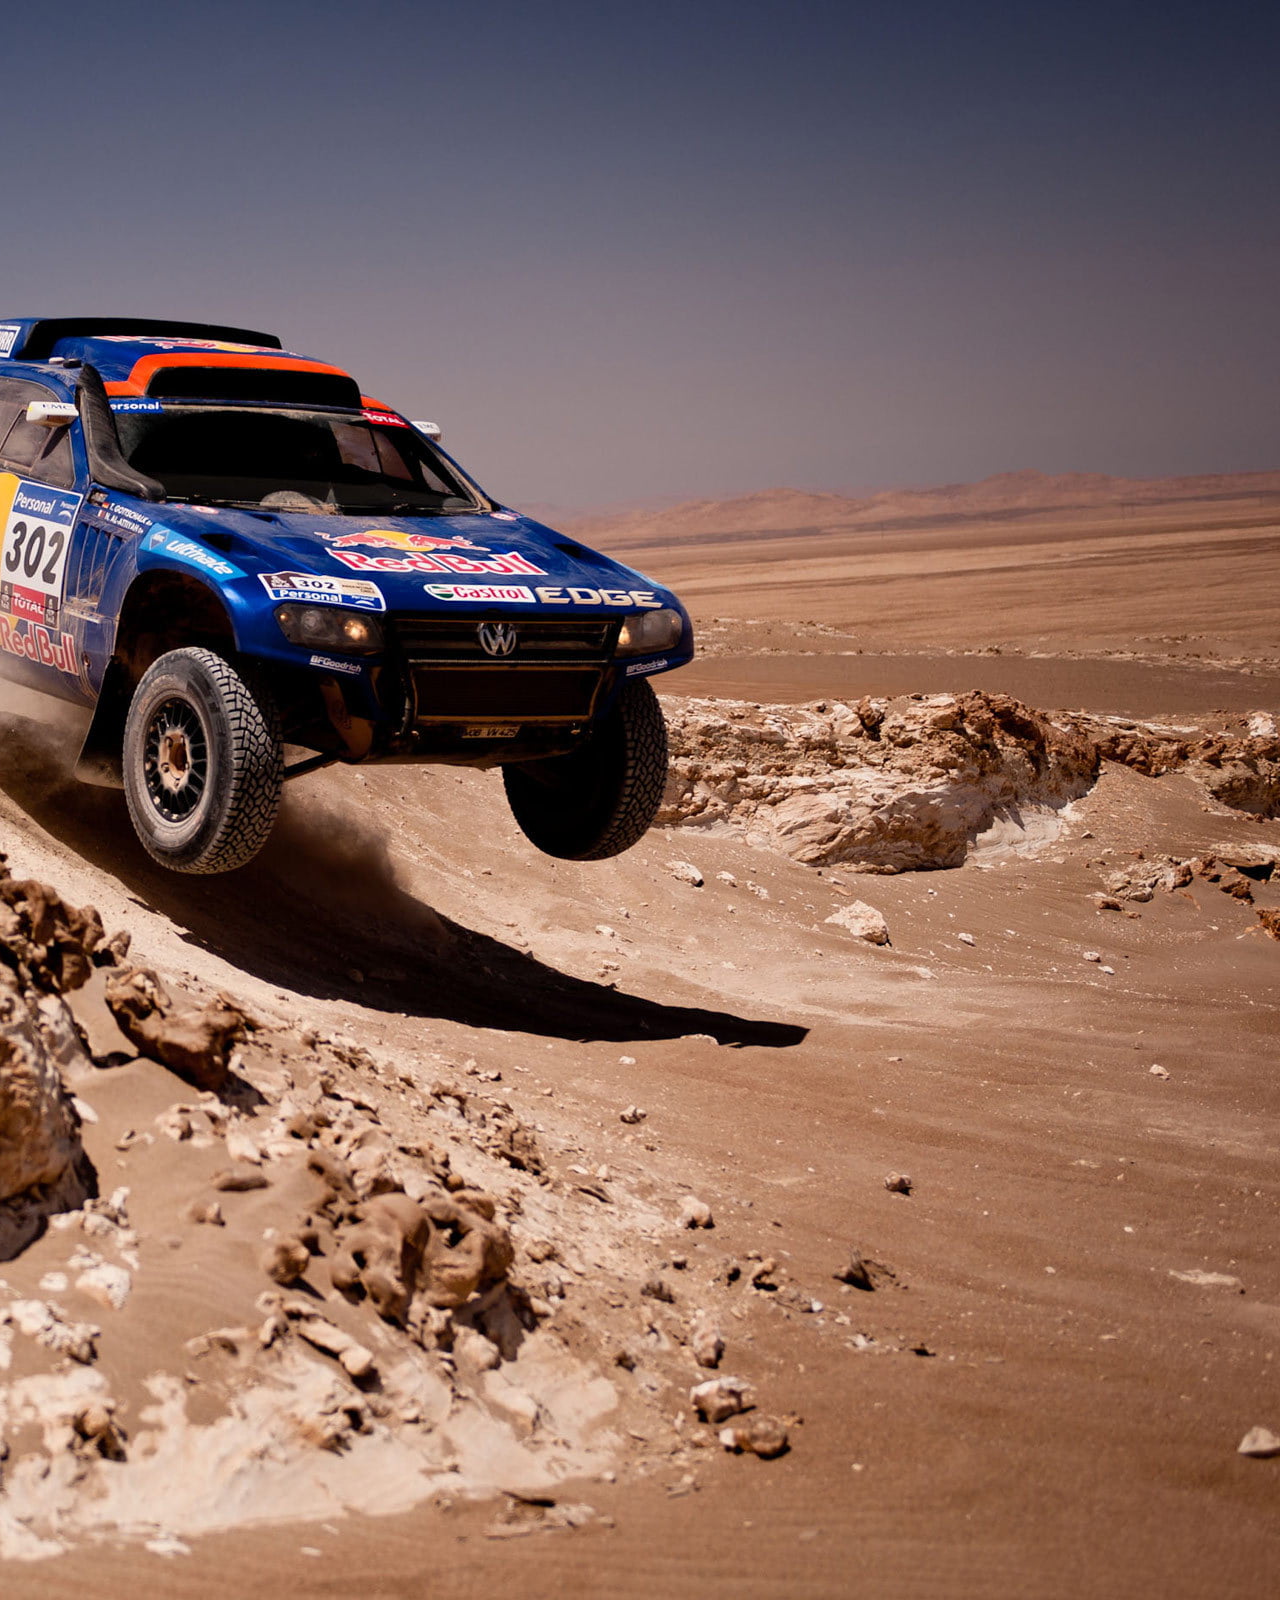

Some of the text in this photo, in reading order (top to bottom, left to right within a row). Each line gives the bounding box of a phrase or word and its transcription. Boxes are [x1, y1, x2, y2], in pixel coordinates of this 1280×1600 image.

[109, 401, 160, 411] ersonal
[14, 492, 57, 514] Personal
[5, 521, 65, 585] 302
[165, 540, 234, 575] ultimate
[325, 548, 549, 576] Red Bull
[280, 589, 342, 603] Personal
[299, 580, 336, 590] 302
[12, 592, 45, 615] TOTAL
[453, 586, 663, 609] Castrol EDGE
[35, 625, 79, 676] Bull
[310, 654, 362, 673] BFGoodrich
